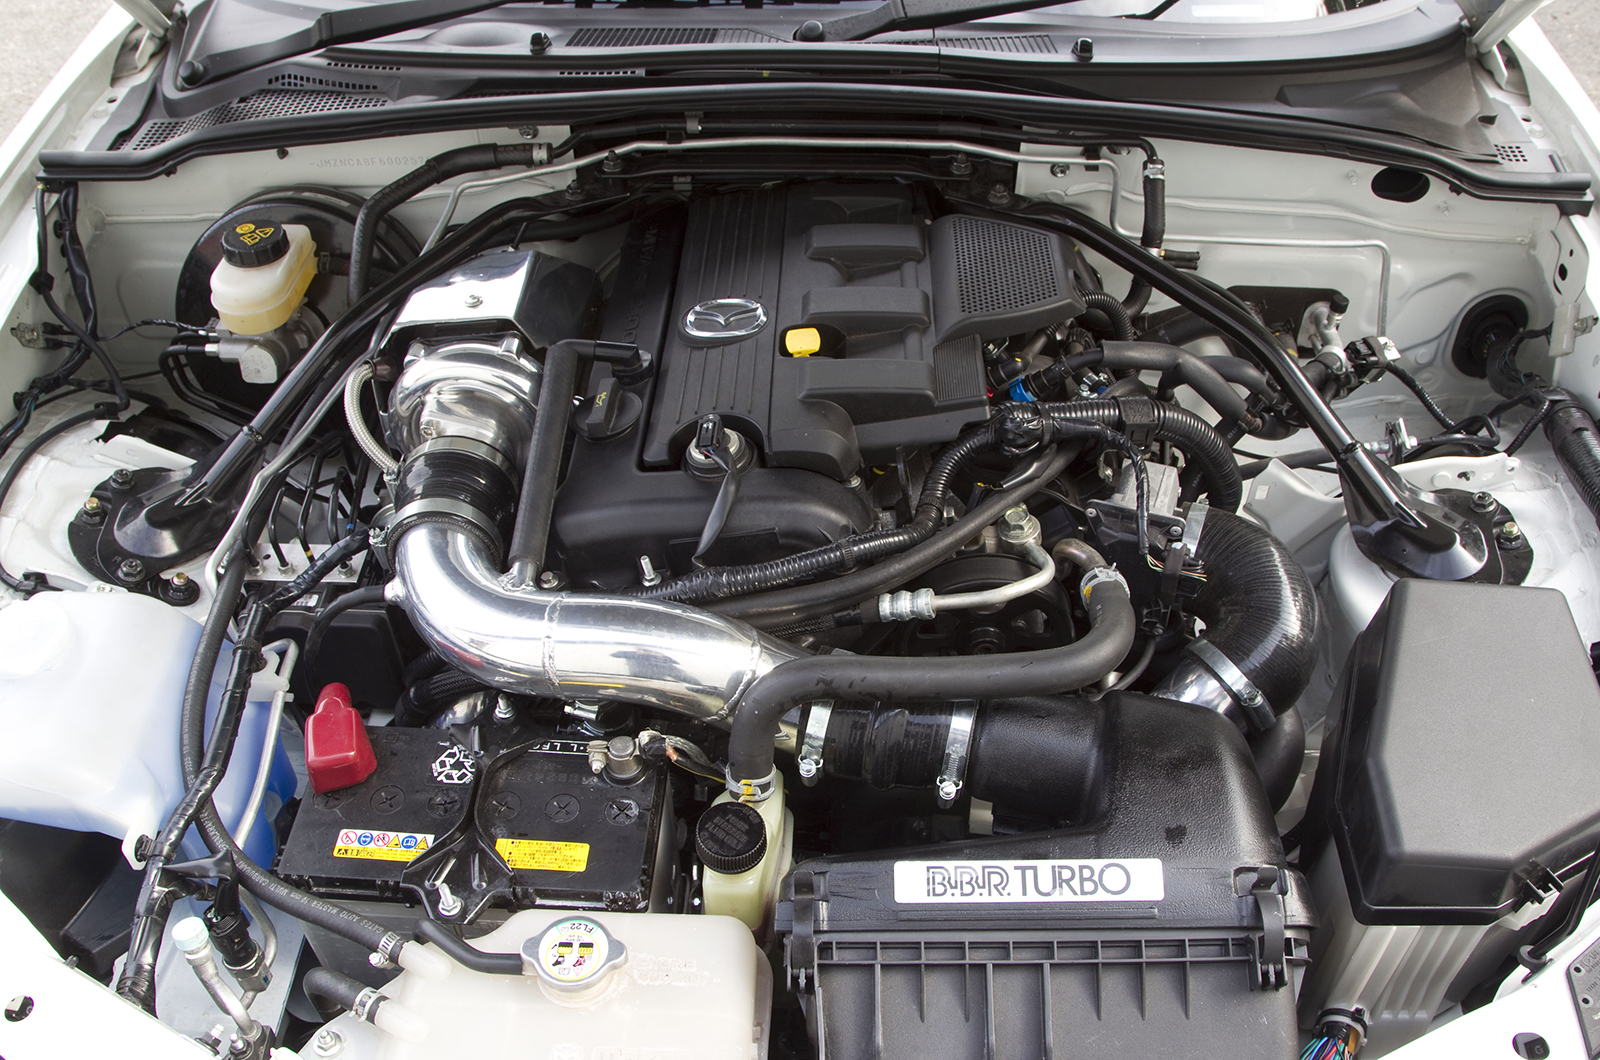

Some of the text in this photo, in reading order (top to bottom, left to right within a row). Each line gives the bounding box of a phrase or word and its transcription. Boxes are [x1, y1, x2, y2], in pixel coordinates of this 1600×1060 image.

[1013, 862, 1132, 897] TURBO
[311, 901, 338, 915] MASTER
[339, 911, 361, 923] AUTO
[361, 921, 385, 934] GATES
[569, 922, 595, 934] FL22
